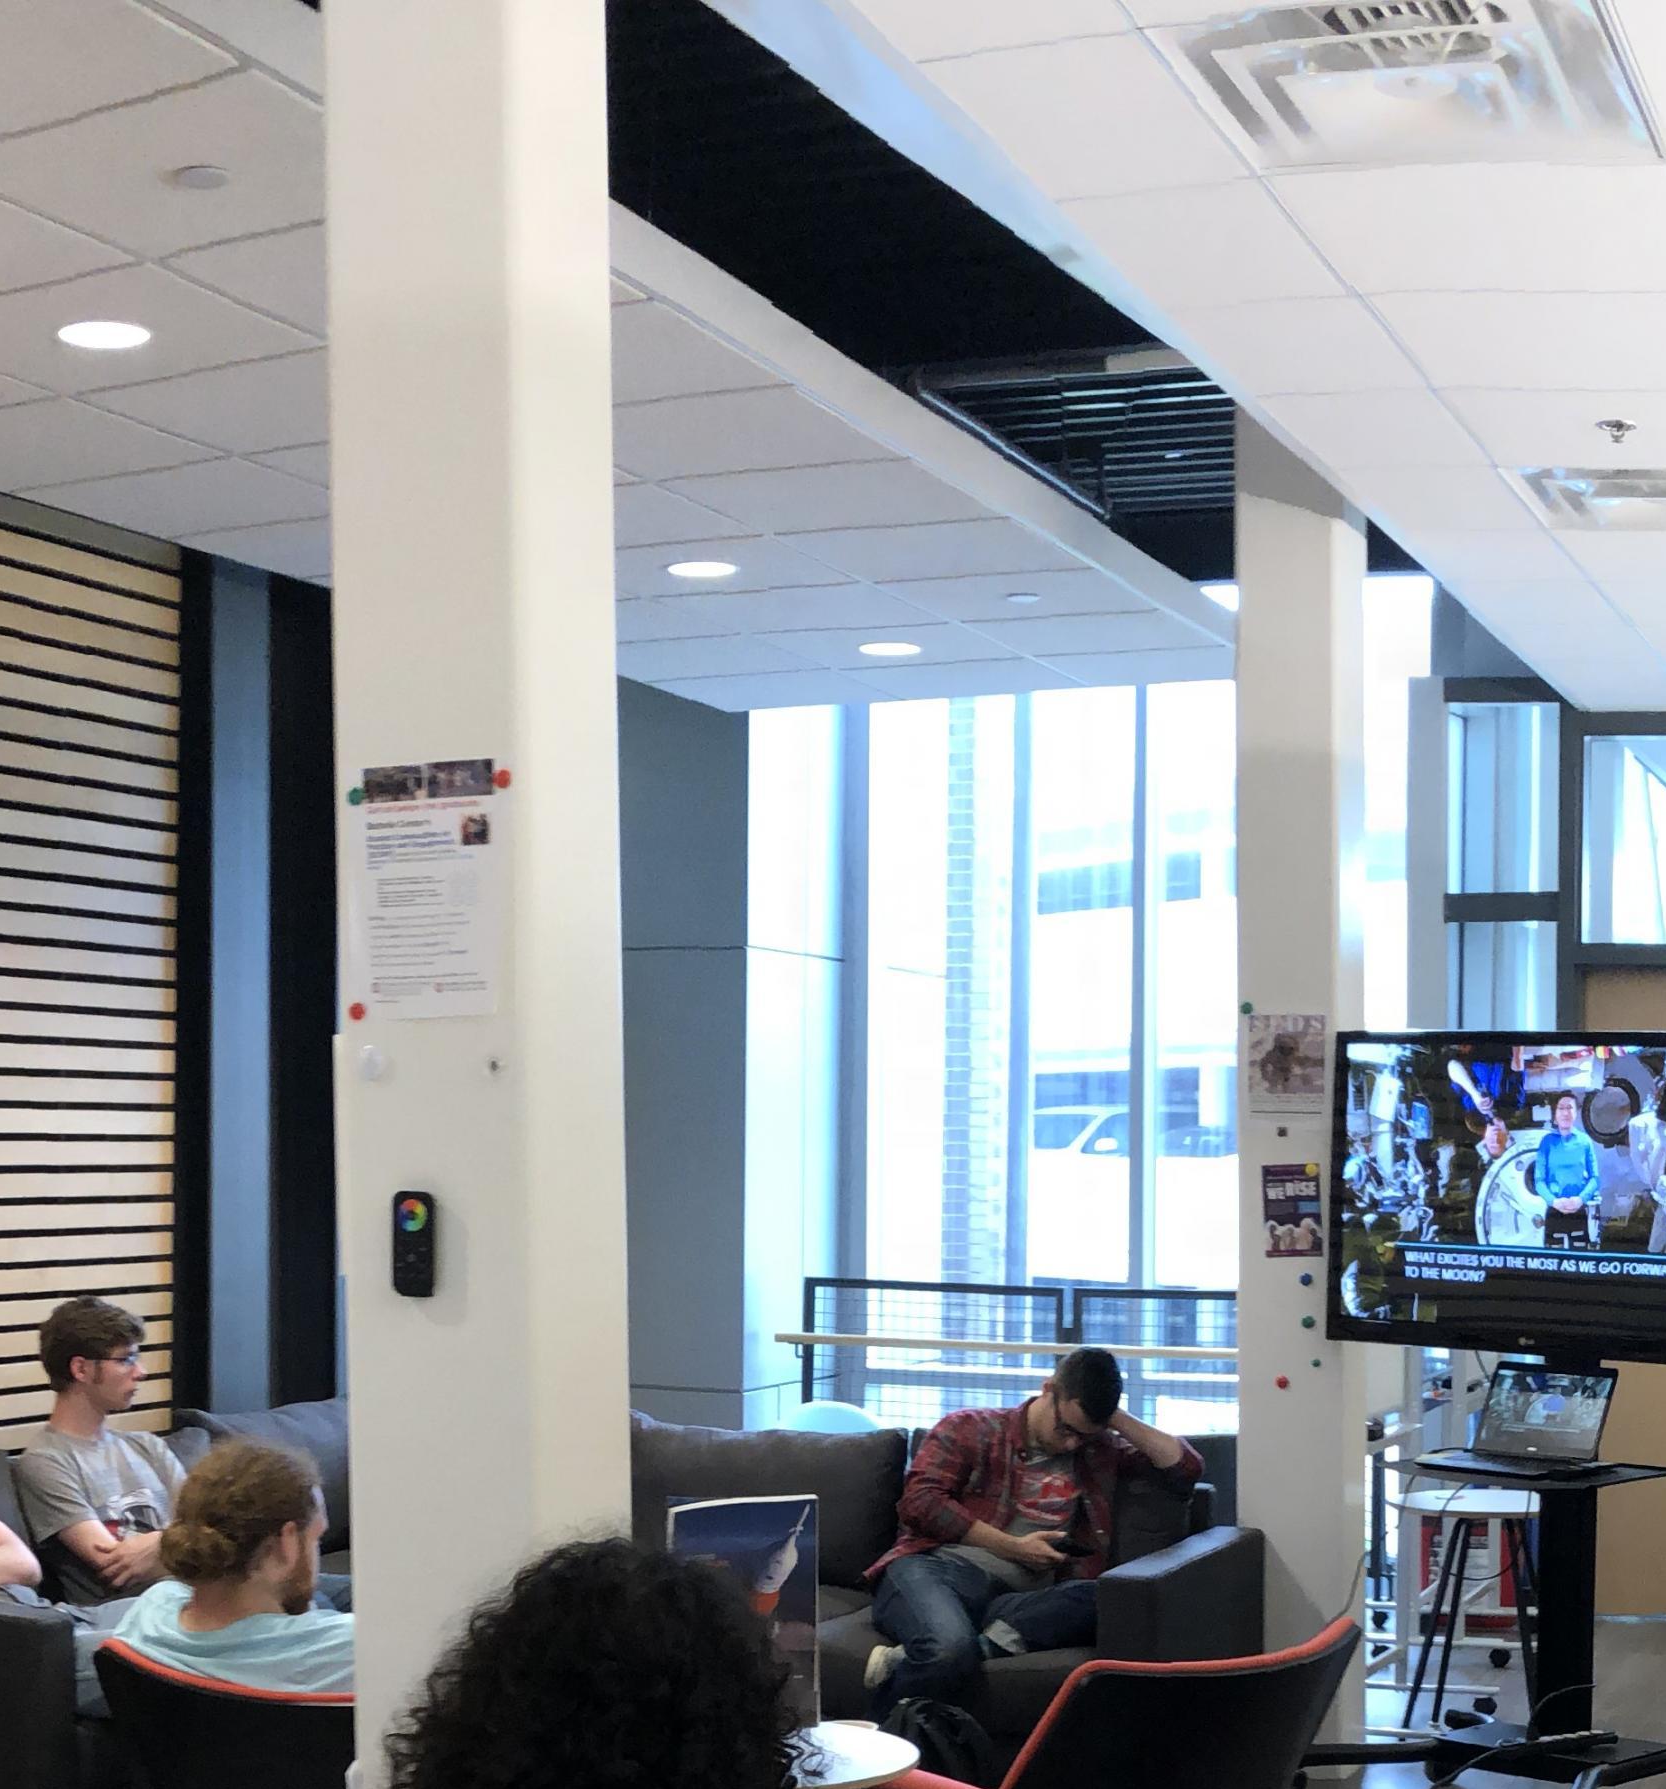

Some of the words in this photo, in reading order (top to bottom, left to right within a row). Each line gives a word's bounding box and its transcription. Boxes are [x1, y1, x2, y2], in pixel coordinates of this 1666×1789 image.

[1404, 1251, 1434, 1264] WHAT
[1436, 1253, 1478, 1267] EXCITES
[1480, 1255, 1503, 1268] YOU
[1506, 1256, 1526, 1269] THE
[1527, 1257, 1559, 1271] MOST
[1560, 1259, 1577, 1272] AS
[1579, 1260, 1596, 1274] WE
[1598, 1261, 1621, 1274] GO
[1404, 1265, 1419, 1279] TO
[1421, 1266, 1440, 1280] THE
[1441, 1267, 1486, 1283] MOON?
